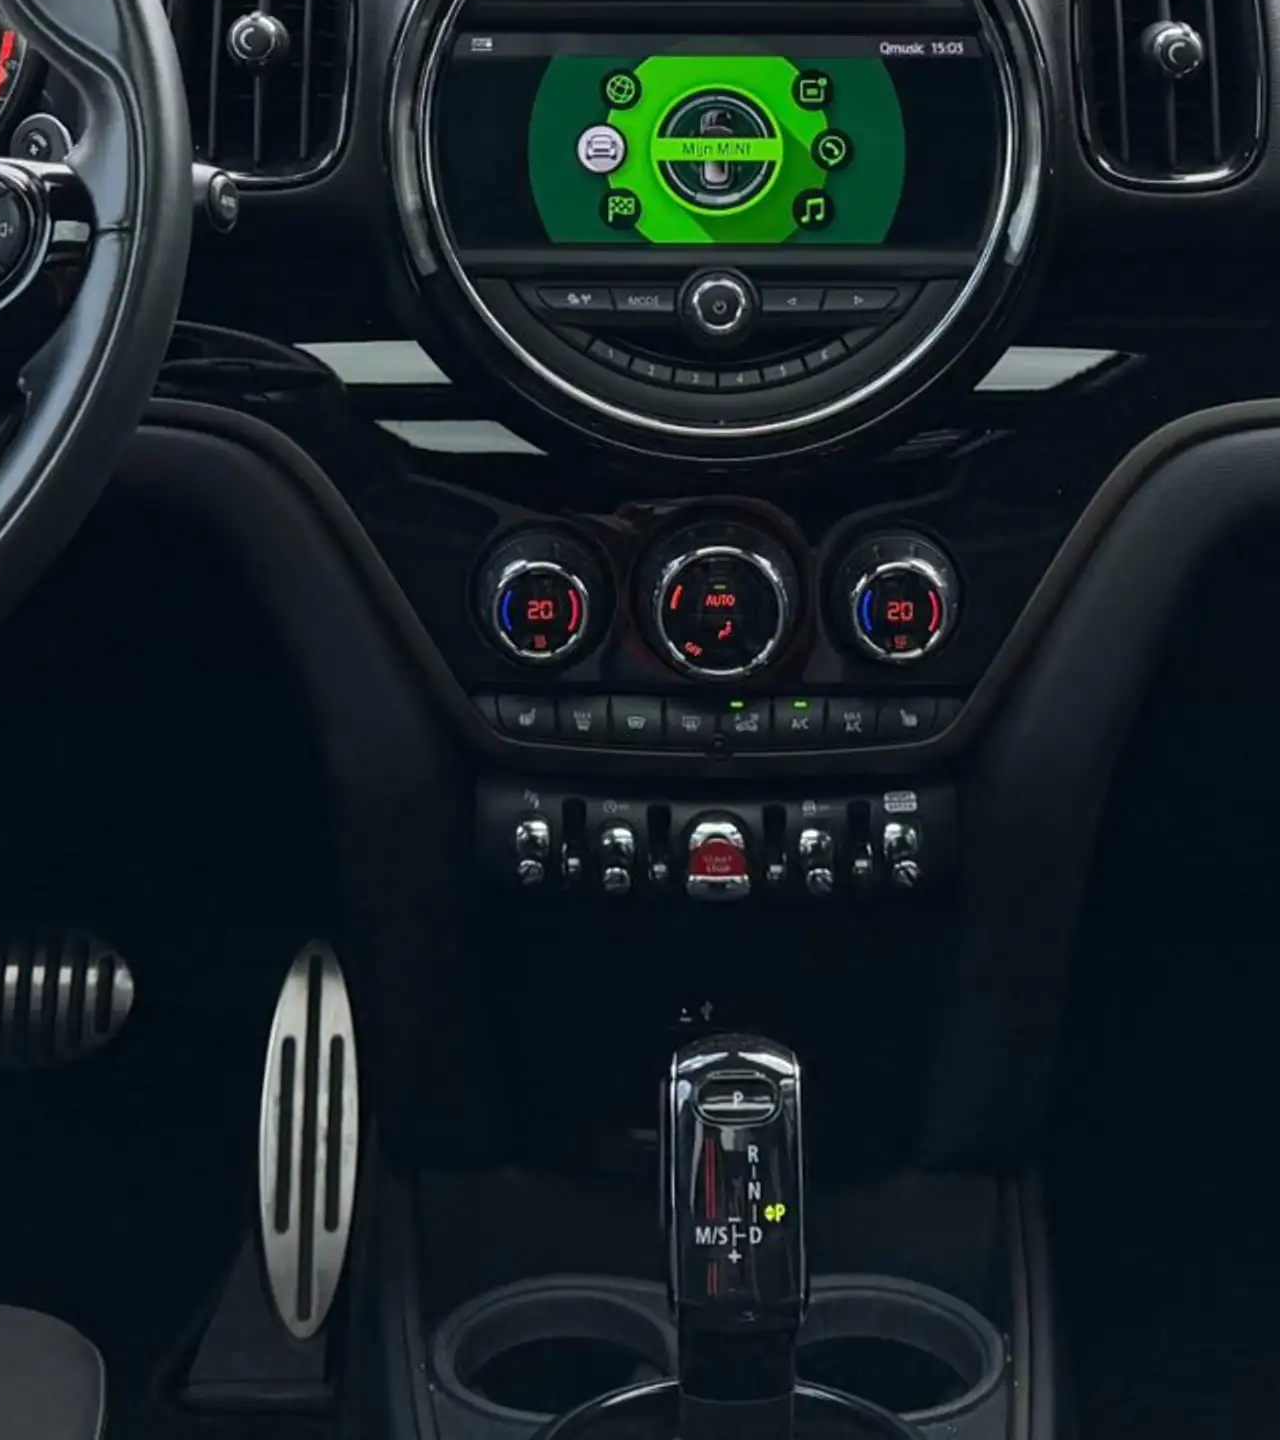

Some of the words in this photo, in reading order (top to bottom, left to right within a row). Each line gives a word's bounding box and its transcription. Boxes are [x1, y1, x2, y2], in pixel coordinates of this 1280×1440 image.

[879, 41, 925, 55] Qmusic
[717, 142, 751, 156] MINI
[627, 295, 660, 306] MODE
[527, 600, 554, 619] 20
[705, 594, 736, 608] AUTO
[887, 601, 914, 621] 20
[791, 718, 811, 730] A/C
[733, 1091, 744, 1107] P
[748, 1144, 760, 1164] R
[748, 1181, 761, 1201] N
[775, 1203, 786, 1223] P
[695, 1226, 728, 1245] M/S
[749, 1226, 763, 1245] D
